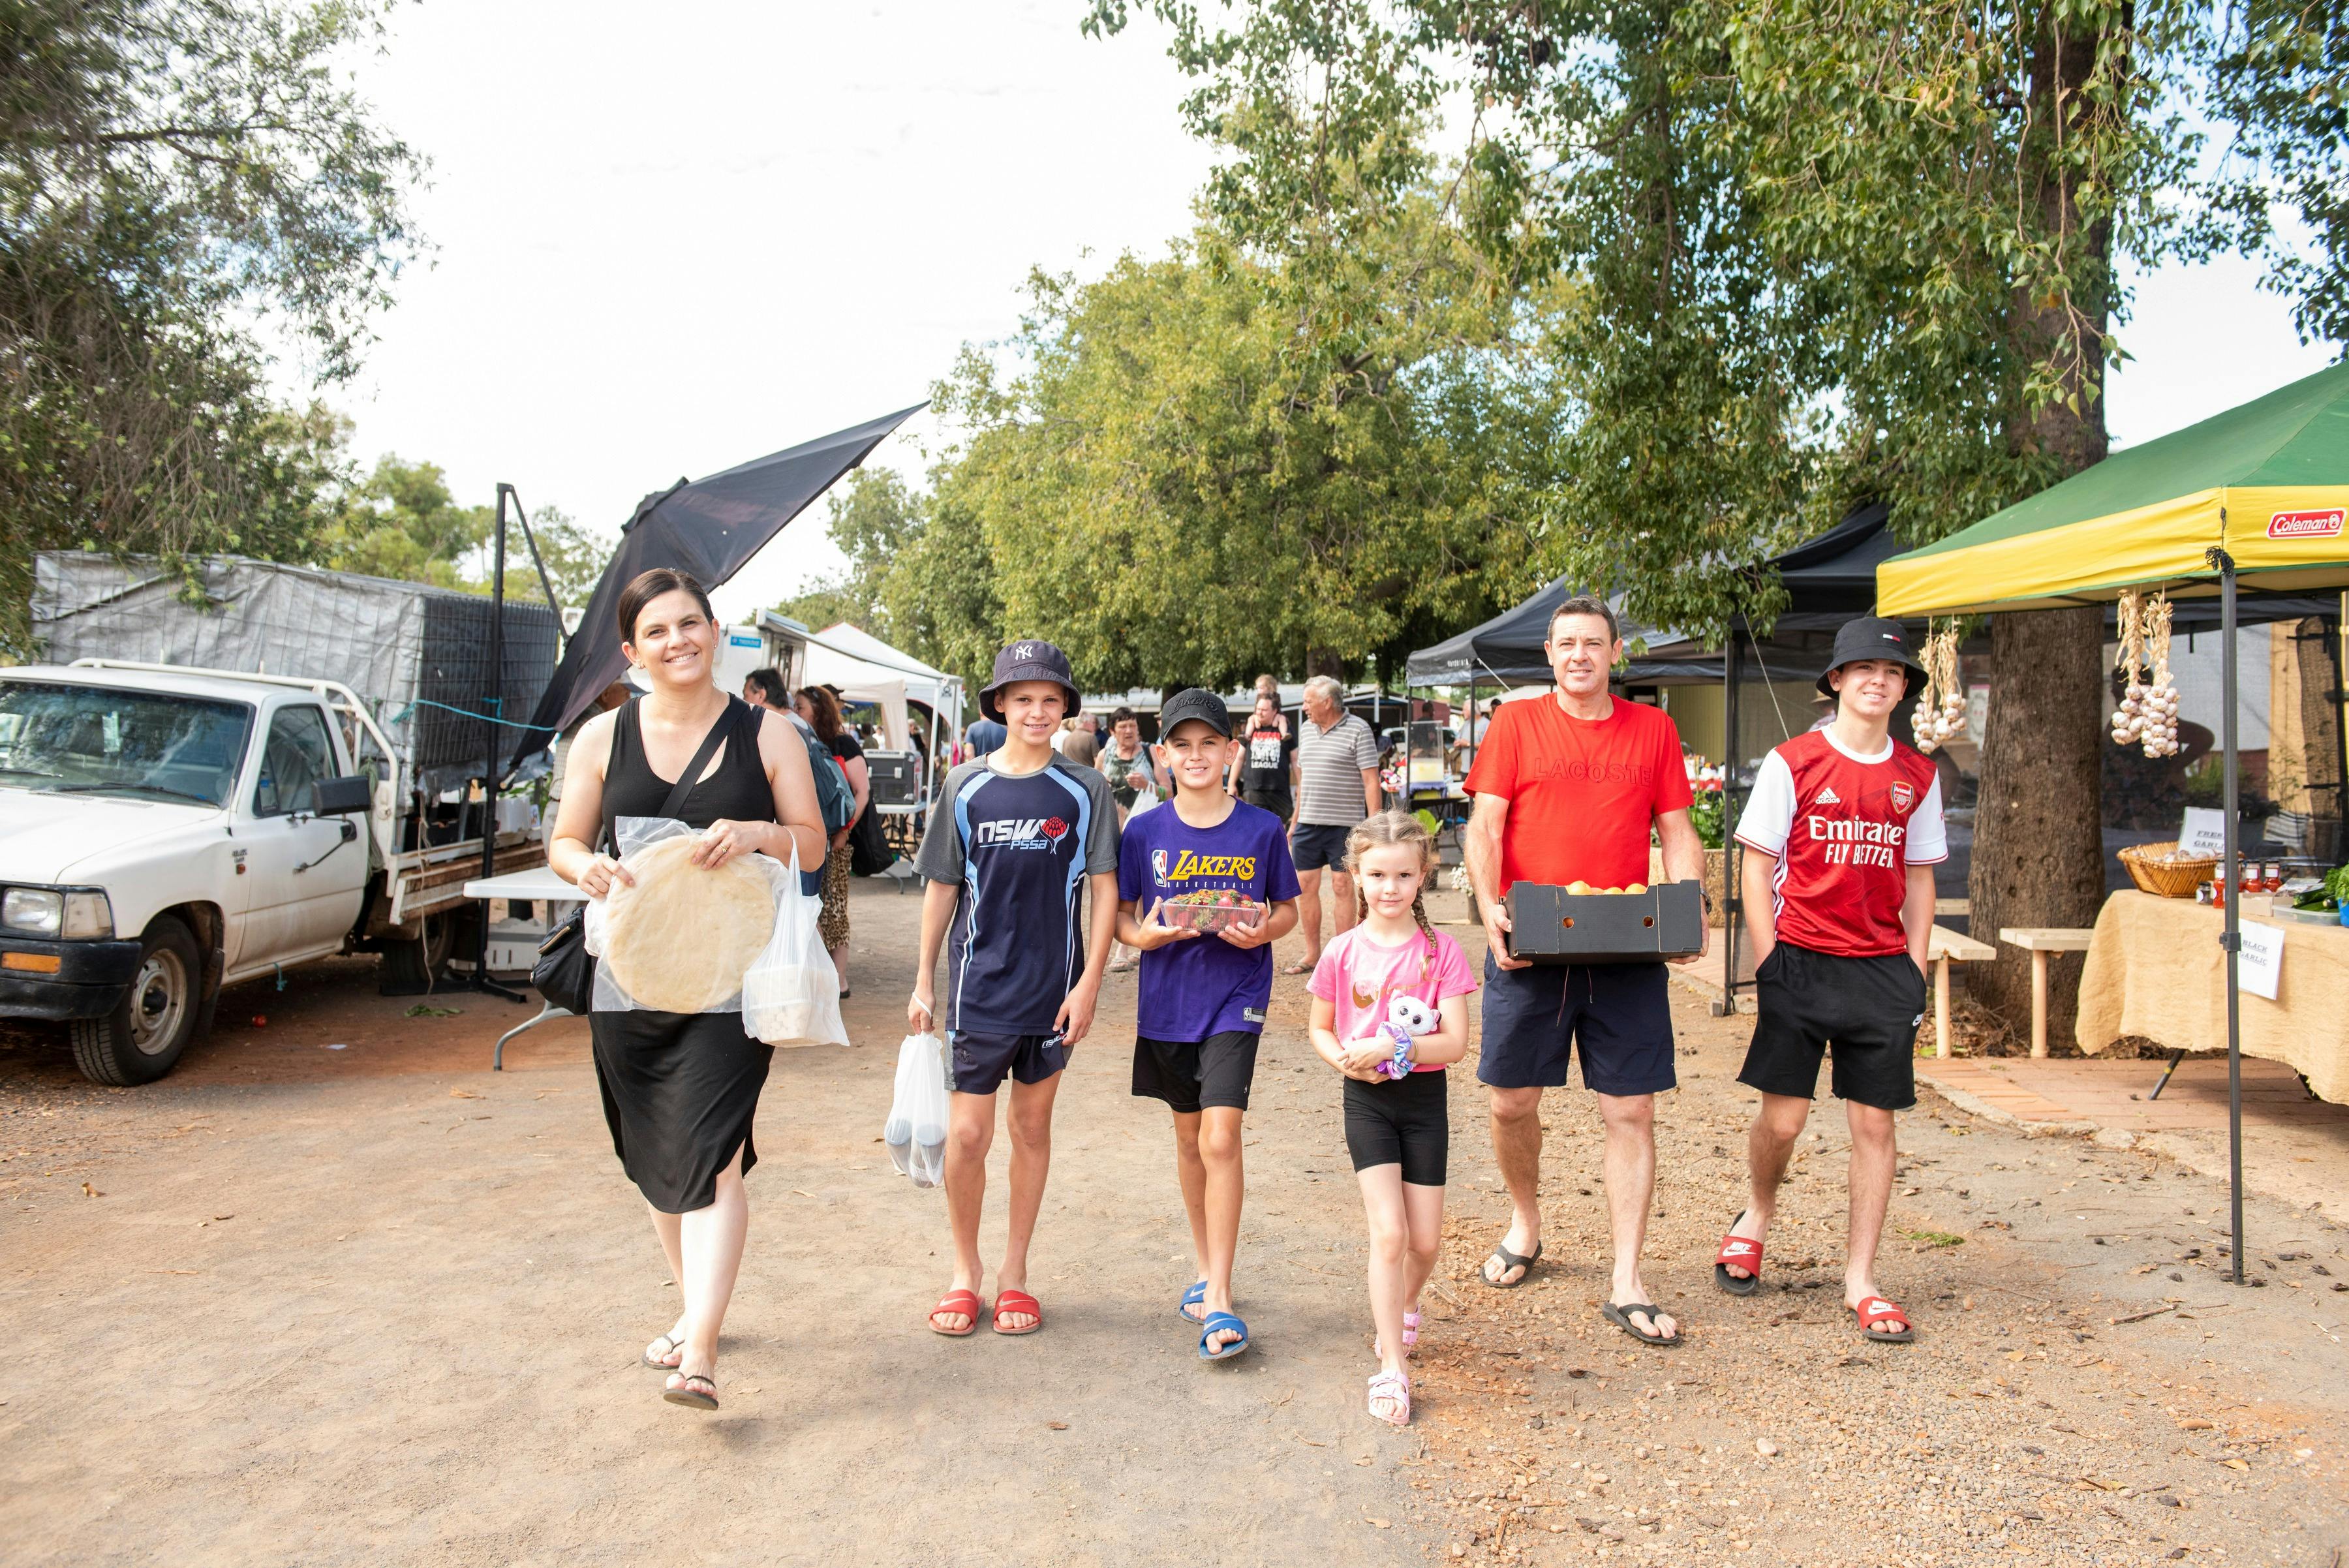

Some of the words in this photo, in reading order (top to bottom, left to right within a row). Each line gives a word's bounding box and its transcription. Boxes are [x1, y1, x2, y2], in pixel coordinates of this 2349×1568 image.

[2274, 516, 2327, 532] Coleman
[1015, 645, 1033, 660] NY
[1251, 761, 1278, 769] LEAGUE
[1533, 757, 1651, 787] LACOSTE
[1808, 815, 1905, 846] Emirate
[1825, 844, 1850, 865] FLY
[1852, 844, 1894, 868] BETTER
[1167, 850, 1256, 881] LAKERS
[2243, 940, 2267, 952] BLACK
[1728, 1242, 1752, 1252] NIKE
